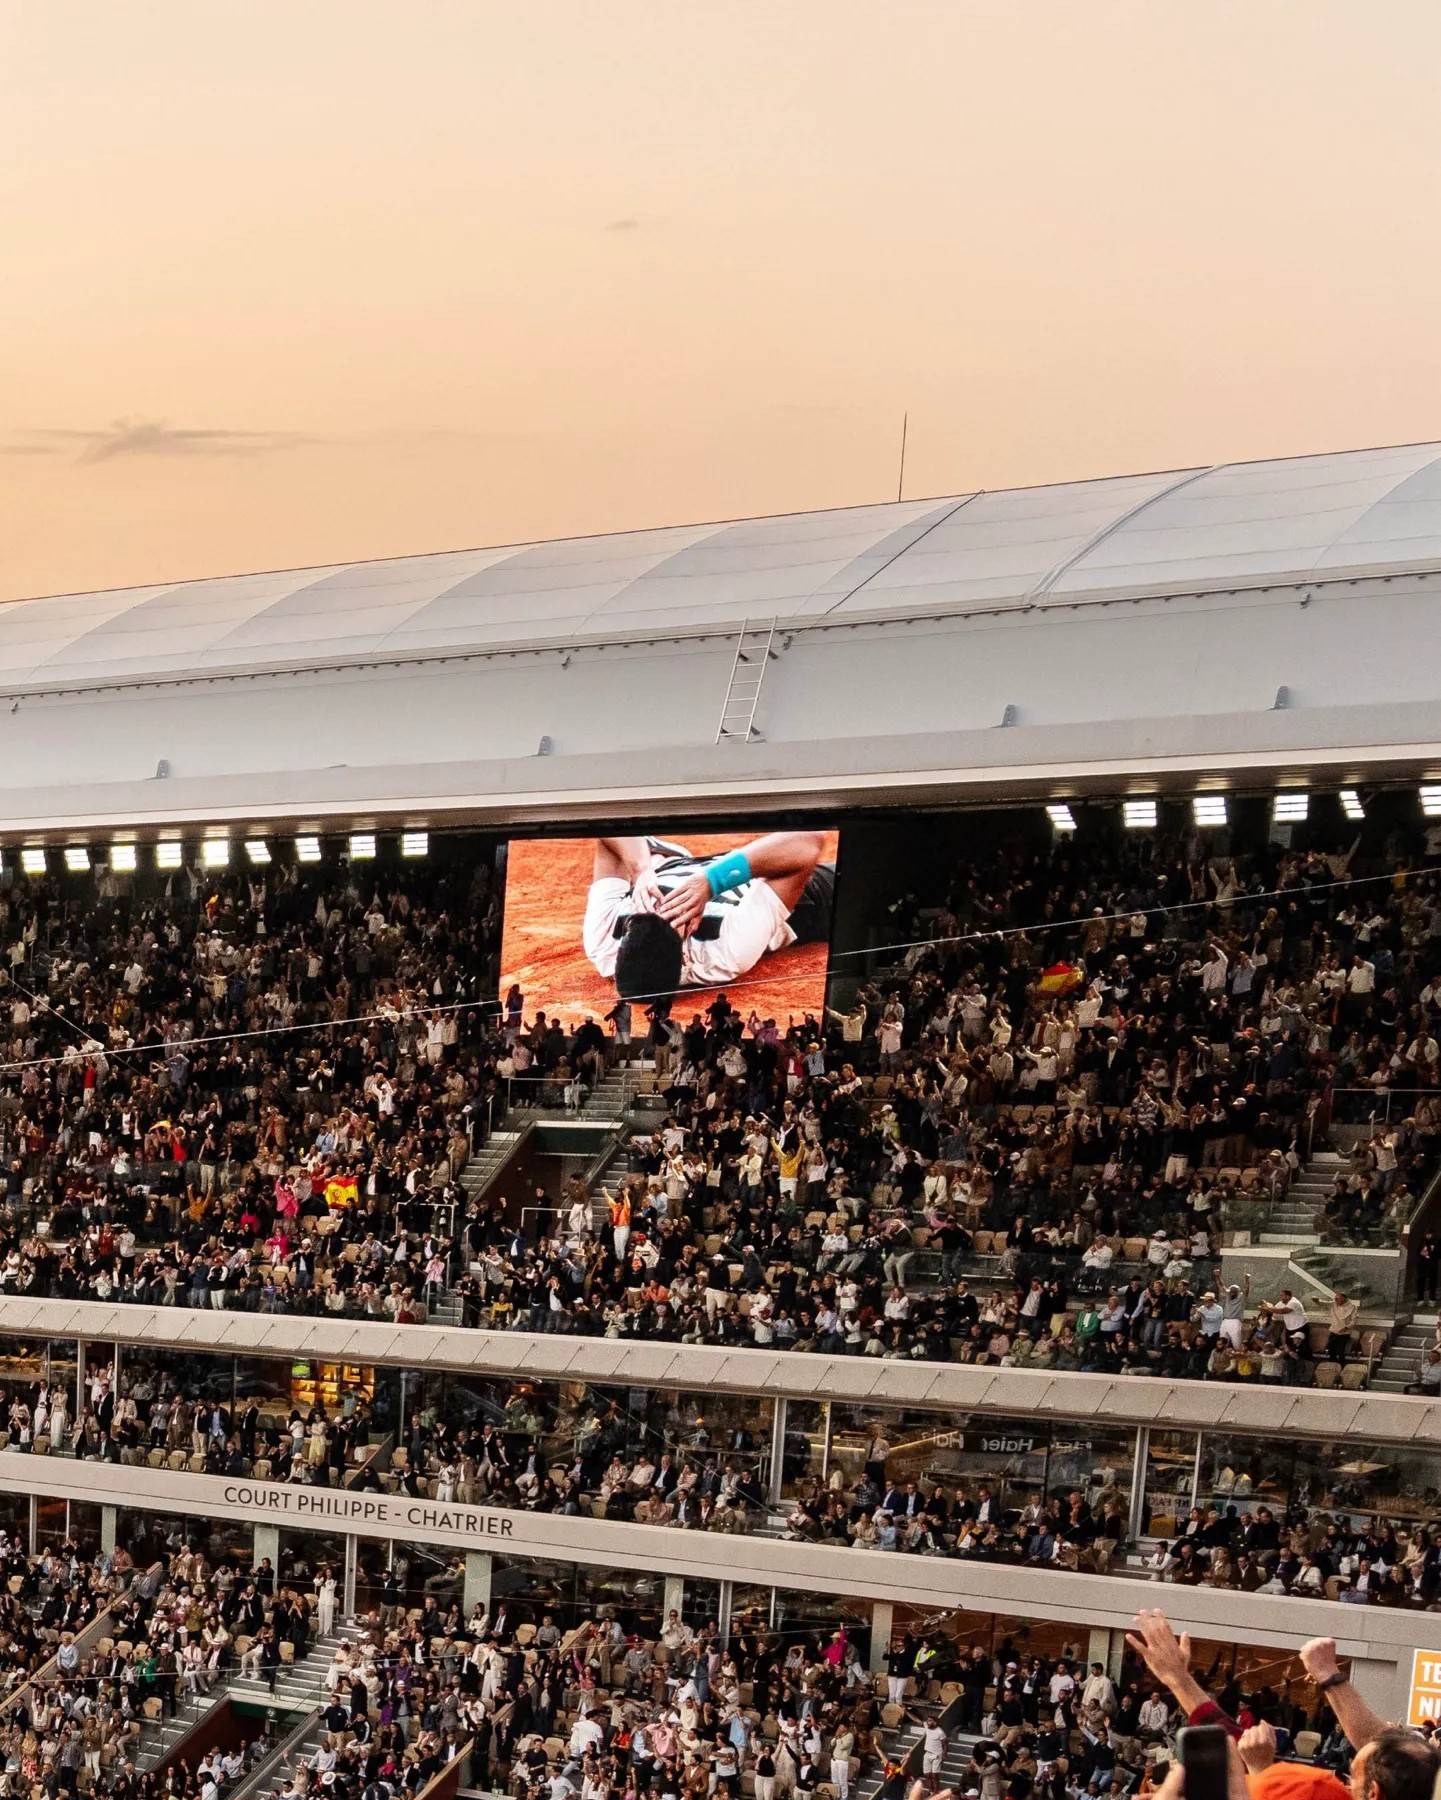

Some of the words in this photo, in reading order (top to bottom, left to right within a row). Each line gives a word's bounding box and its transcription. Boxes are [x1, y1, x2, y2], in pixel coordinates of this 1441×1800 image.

[223, 1486, 292, 1506] COURT
[298, 1494, 388, 1520] PHILIPPE
[407, 1508, 513, 1536] CHATRIER
